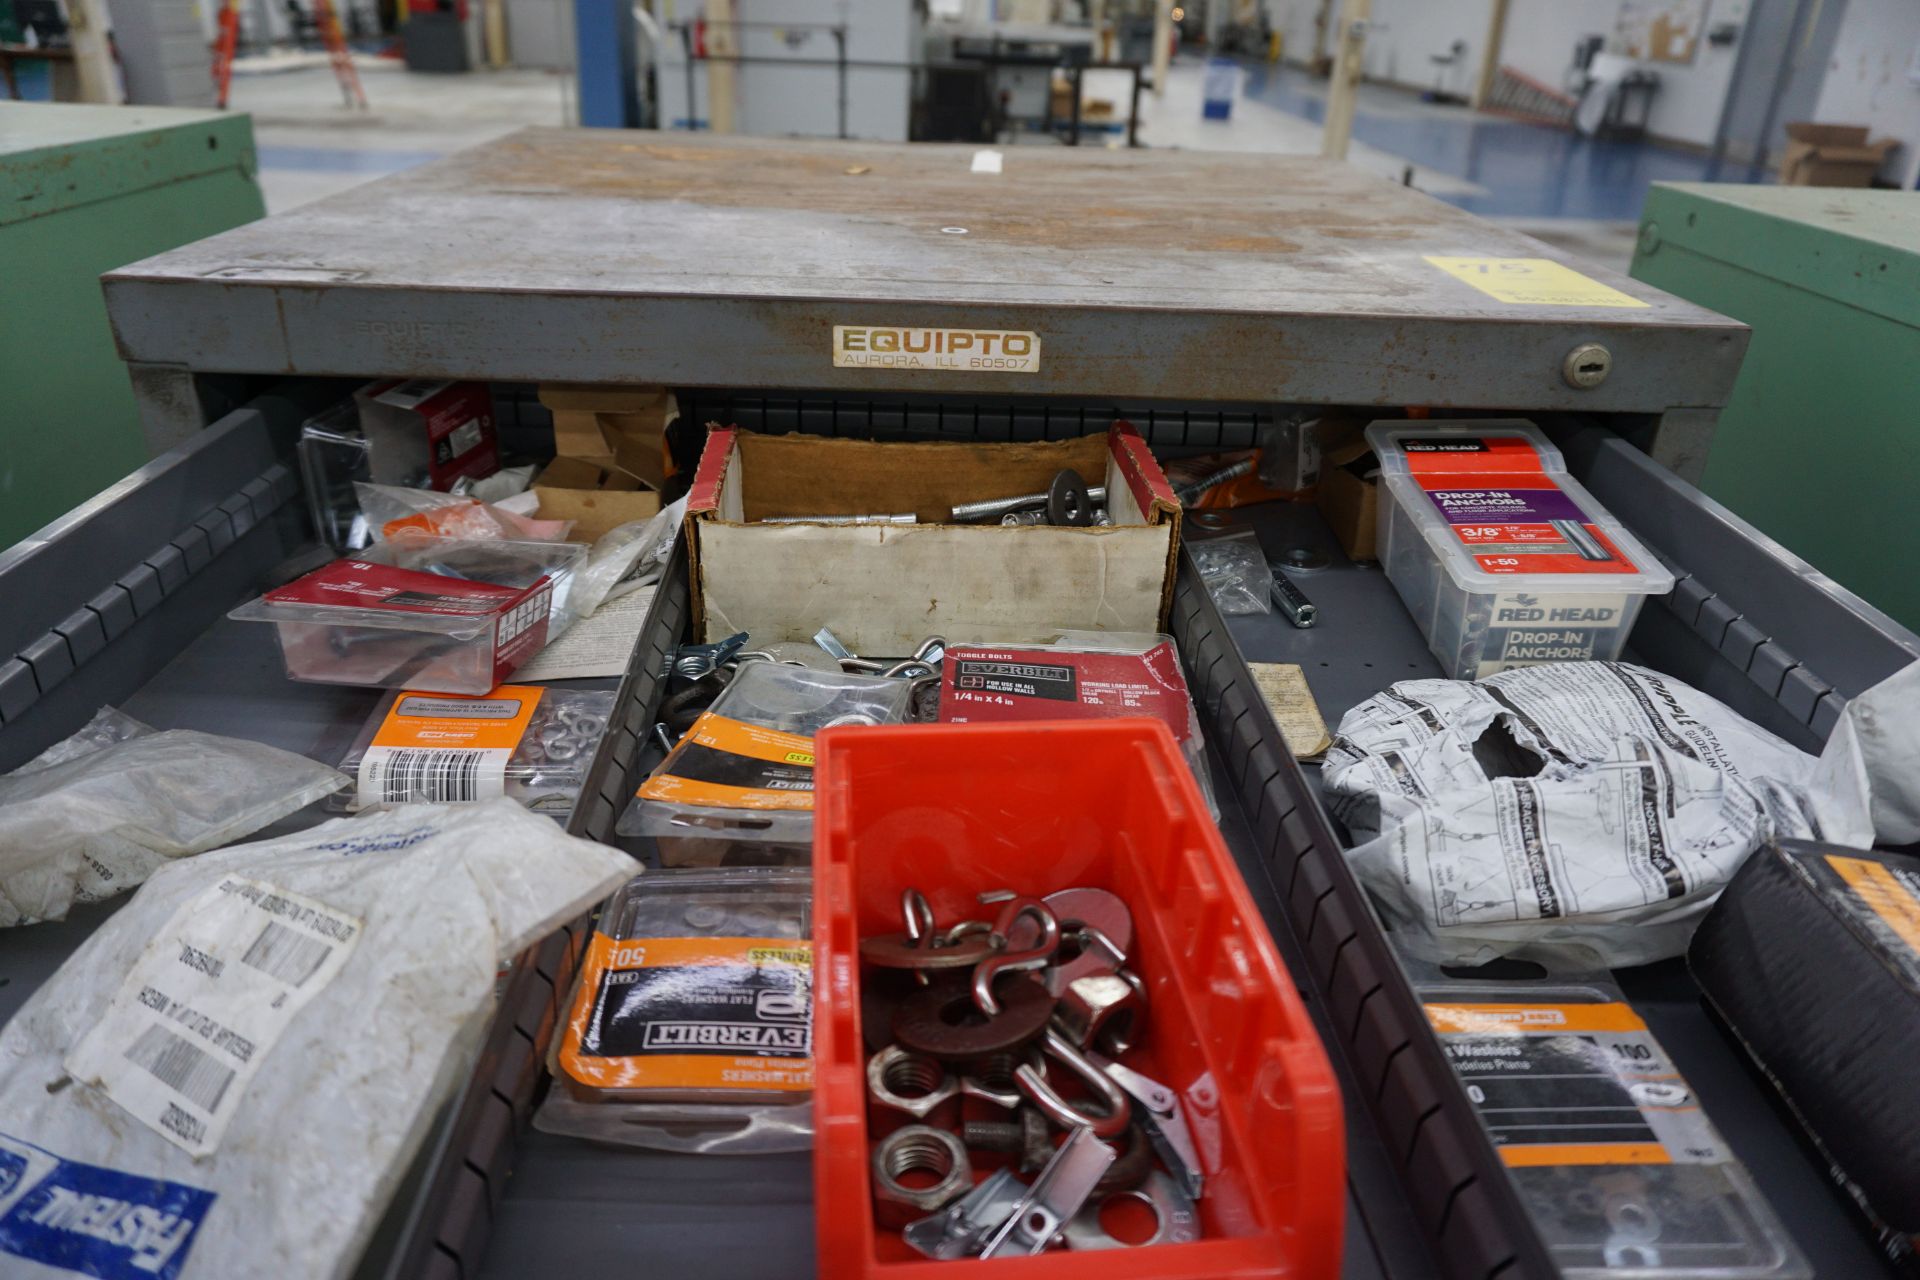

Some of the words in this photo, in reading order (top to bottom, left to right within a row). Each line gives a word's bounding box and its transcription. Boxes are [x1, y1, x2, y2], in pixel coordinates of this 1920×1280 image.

[843, 329, 1031, 356] EQUIPTO
[843, 354, 925, 368] AURORA,
[936, 356, 960, 367] ILL
[969, 358, 1030, 369] 60507
[1434, 492, 1512, 500] DROP-IN
[1442, 498, 1526, 507] ANCHORS
[1498, 608, 1545, 621] RED
[1549, 608, 1614, 621] HEAD
[1509, 631, 1584, 644] DROP-IN
[956, 652, 987, 660] TOGGLE
[1506, 646, 1592, 658] ANCHORS
[966, 663, 1065, 680] EVERBILT
[986, 685, 1012, 693] HOLLOW
[1014, 687, 1036, 695] WALLS
[1081, 681, 1110, 689] WORKING
[953, 692, 972, 702] 1/4
[974, 694, 983, 702] in
[985, 695, 993, 703] x
[994, 696, 1003, 704] 4
[1004, 698, 1014, 706] in
[1082, 696, 1098, 705] 120
[1125, 698, 1136, 707] 85
[1685, 730, 1721, 771] GUIDELIN
[1645, 801, 1660, 833] HOOK
[1528, 848, 1554, 914] ACCESSORY
[618, 948, 645, 966] 50
[751, 950, 813, 963] TAINLESS
[652, 1025, 803, 1047] EVERBILT
[1452, 1041, 1522, 1057] Washers
[1612, 1043, 1652, 1060] 100
